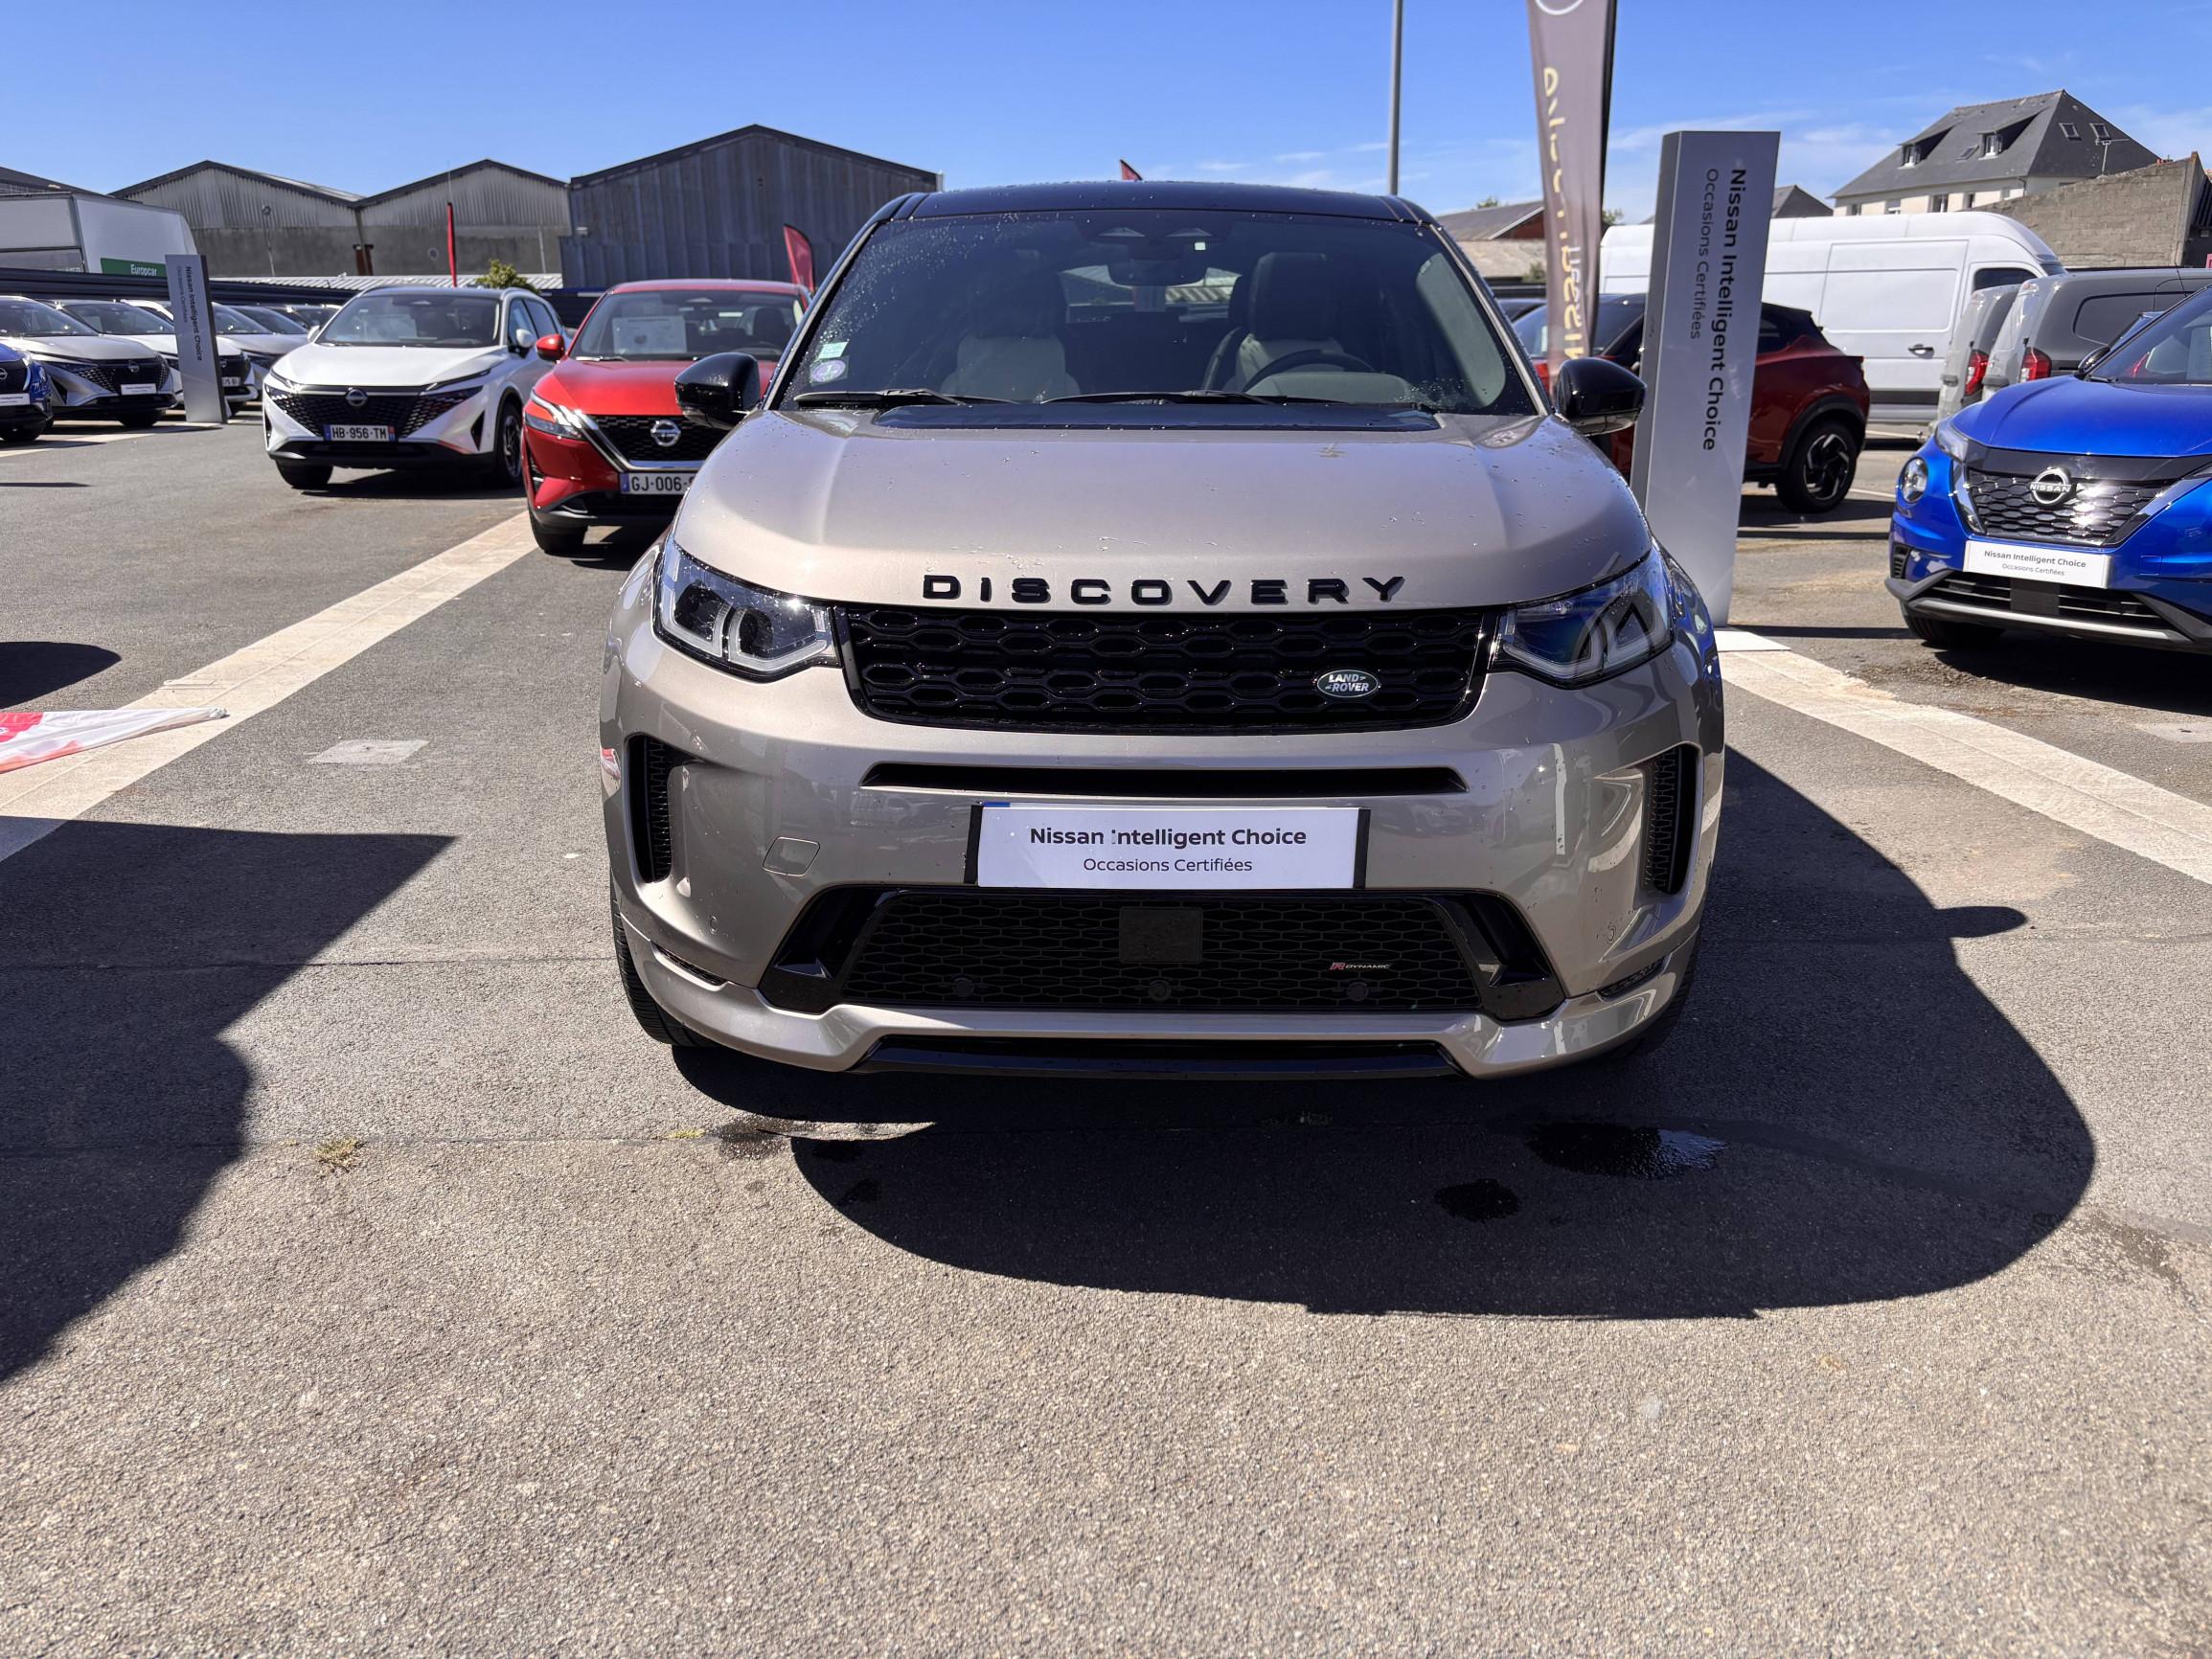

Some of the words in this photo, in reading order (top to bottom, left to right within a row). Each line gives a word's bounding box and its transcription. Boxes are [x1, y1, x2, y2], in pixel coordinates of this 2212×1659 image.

[1699, 168, 1719, 257] Occasions
[1724, 169, 1747, 247] Nissan
[130, 263, 158, 277] Europcar
[1690, 261, 1709, 339] Certifiées
[189, 293, 200, 334] Intelligent
[1711, 255, 1737, 372] Intelligent
[194, 334, 203, 361] Choice
[1703, 377, 1724, 450] Choice
[2029, 482, 2071, 493] NISSAN
[1983, 550, 2012, 560] Nissan
[2013, 553, 2056, 566] Intelligent
[2057, 557, 2087, 568] Choice
[2001, 562, 2034, 574] Occasions
[2034, 566, 2065, 577] Certifiées
[923, 574, 1406, 605] DISCOVERY
[1328, 673, 1359, 683] LAND
[1331, 682, 1370, 693] ROVER
[1030, 827, 1105, 845] Nissan
[1231, 828, 1307, 845] Choice
[1083, 858, 1170, 872] Occasions
[1174, 857, 1253, 872] Certifiées
